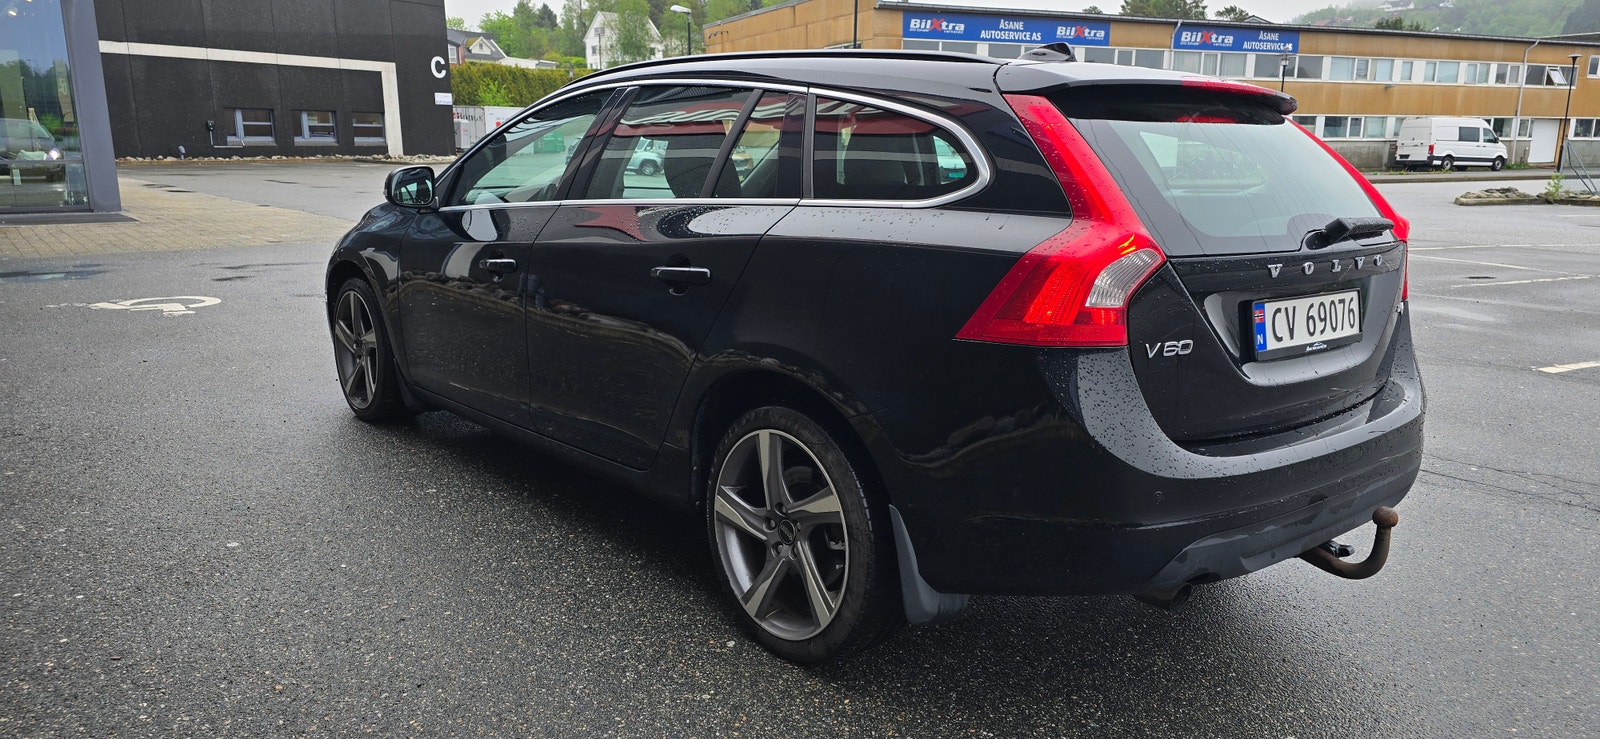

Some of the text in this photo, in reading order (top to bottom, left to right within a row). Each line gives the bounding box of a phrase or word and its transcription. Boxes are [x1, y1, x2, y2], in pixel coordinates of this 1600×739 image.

[909, 17, 966, 32] BilXtra
[999, 18, 1024, 30] ÅSANE
[980, 30, 1042, 41] AUTOSERVICE AS
[1056, 25, 1105, 38] BilXtra
[1181, 30, 1234, 44] BilXtra
[1258, 30, 1280, 41] ÅSANE
[431, 56, 447, 79] C
[1267, 254, 1383, 278] VOLVO
[1271, 297, 1356, 343] CV 69076
[1257, 333, 1264, 345] N
[1145, 339, 1194, 359] V60
